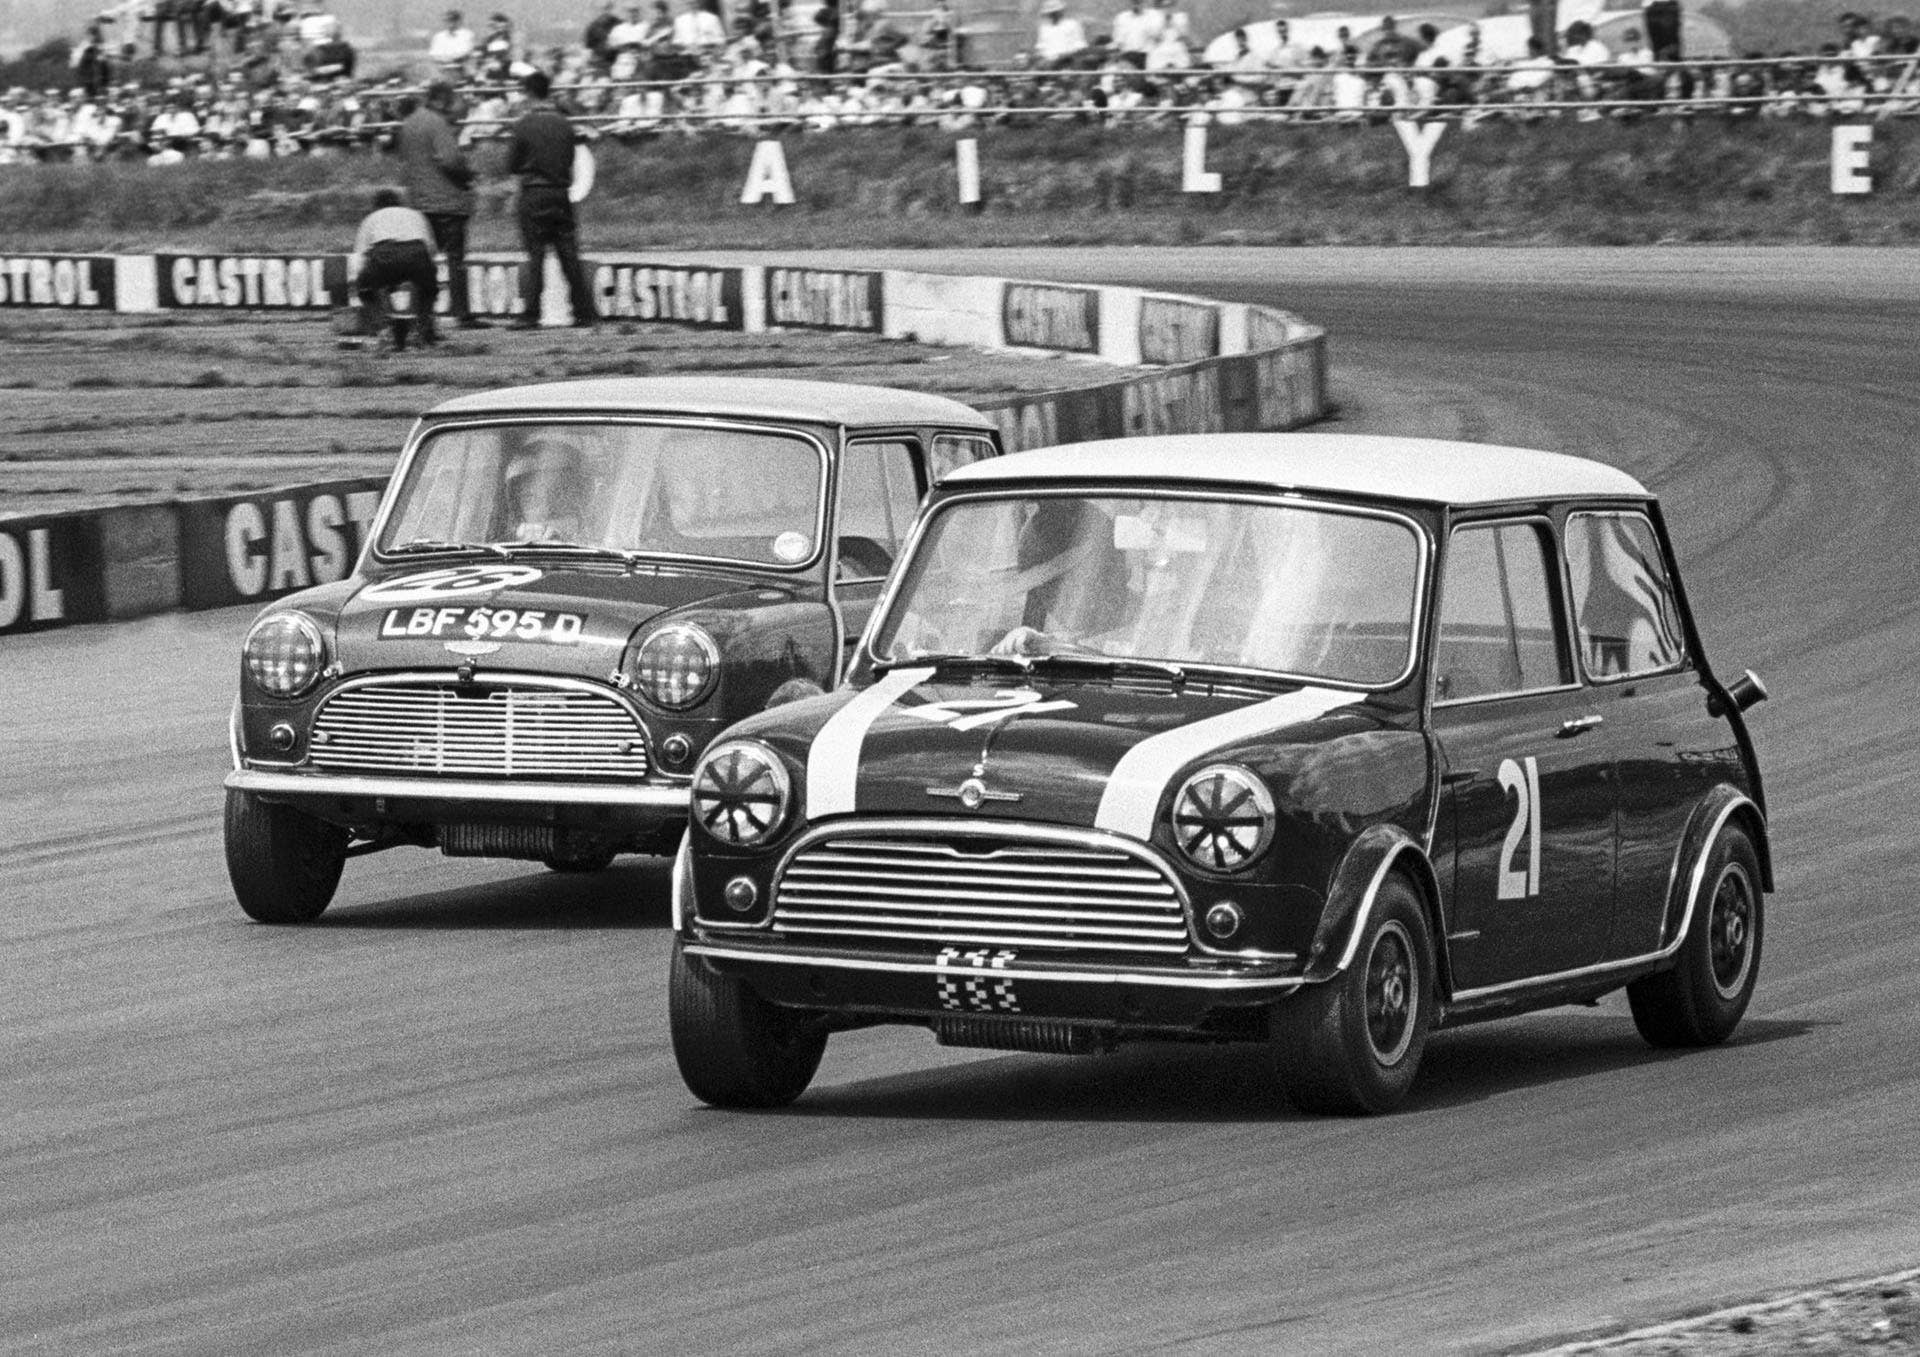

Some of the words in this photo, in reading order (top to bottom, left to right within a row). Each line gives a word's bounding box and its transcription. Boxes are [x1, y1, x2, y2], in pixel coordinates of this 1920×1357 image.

[1831, 125, 1874, 193] E
[172, 257, 331, 306] CASTROL
[594, 265, 728, 322] CASTROL
[382, 608, 465, 636] LBF
[463, 607, 546, 640] 595
[1497, 756, 1540, 900] 21
